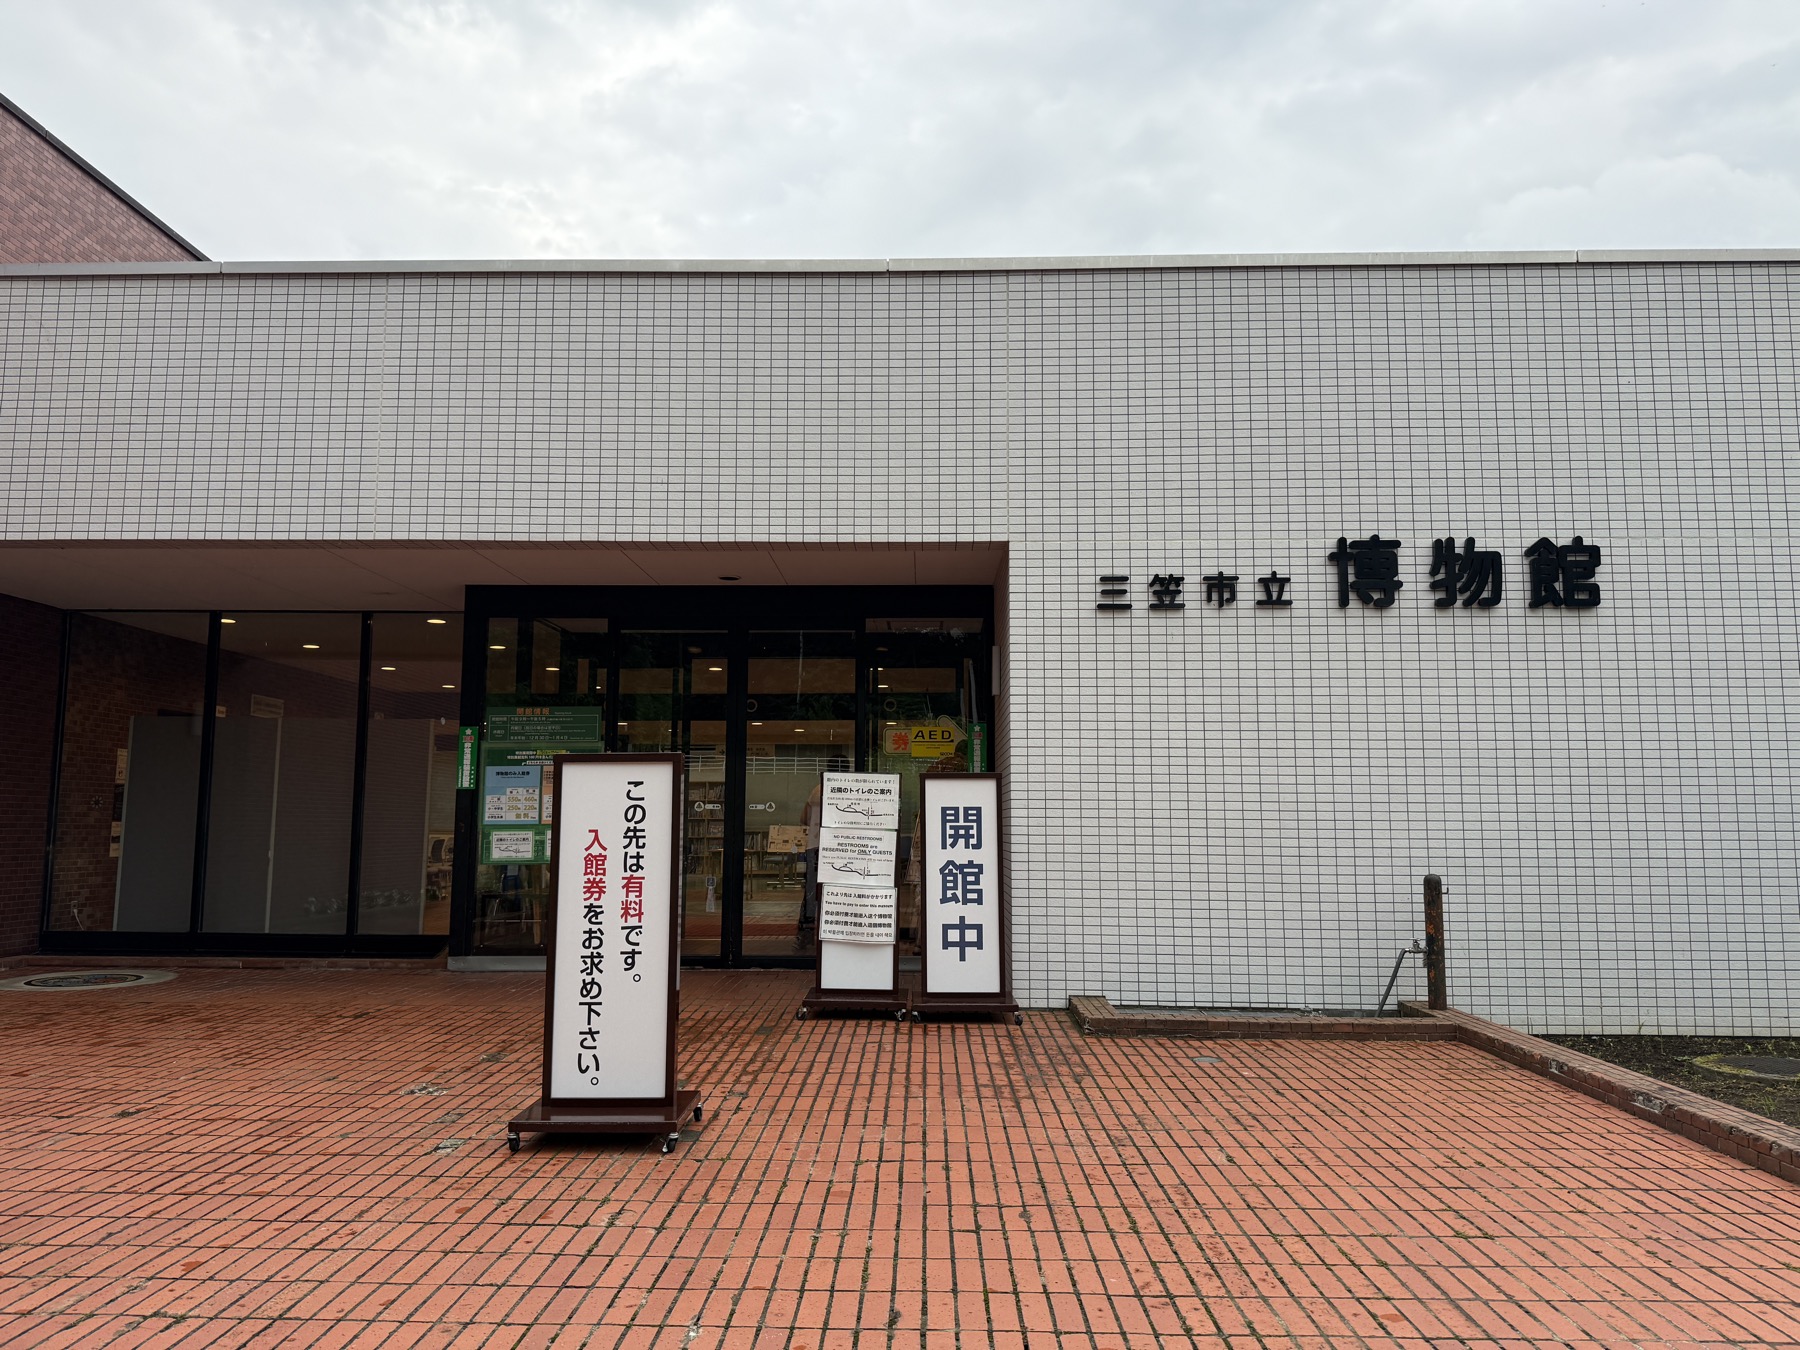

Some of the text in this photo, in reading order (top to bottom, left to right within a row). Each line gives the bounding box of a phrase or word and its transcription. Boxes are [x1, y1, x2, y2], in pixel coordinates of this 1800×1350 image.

[1097, 534, 1601, 609] 三笠市立 博物館
[830, 786, 892, 796] 近隣のトイレのご案内
[913, 730, 952, 740] AED
[618, 780, 647, 983] この先は有料です。
[938, 806, 984, 962] 開館中
[576, 829, 608, 1086] 入館券をお求め下さい。
